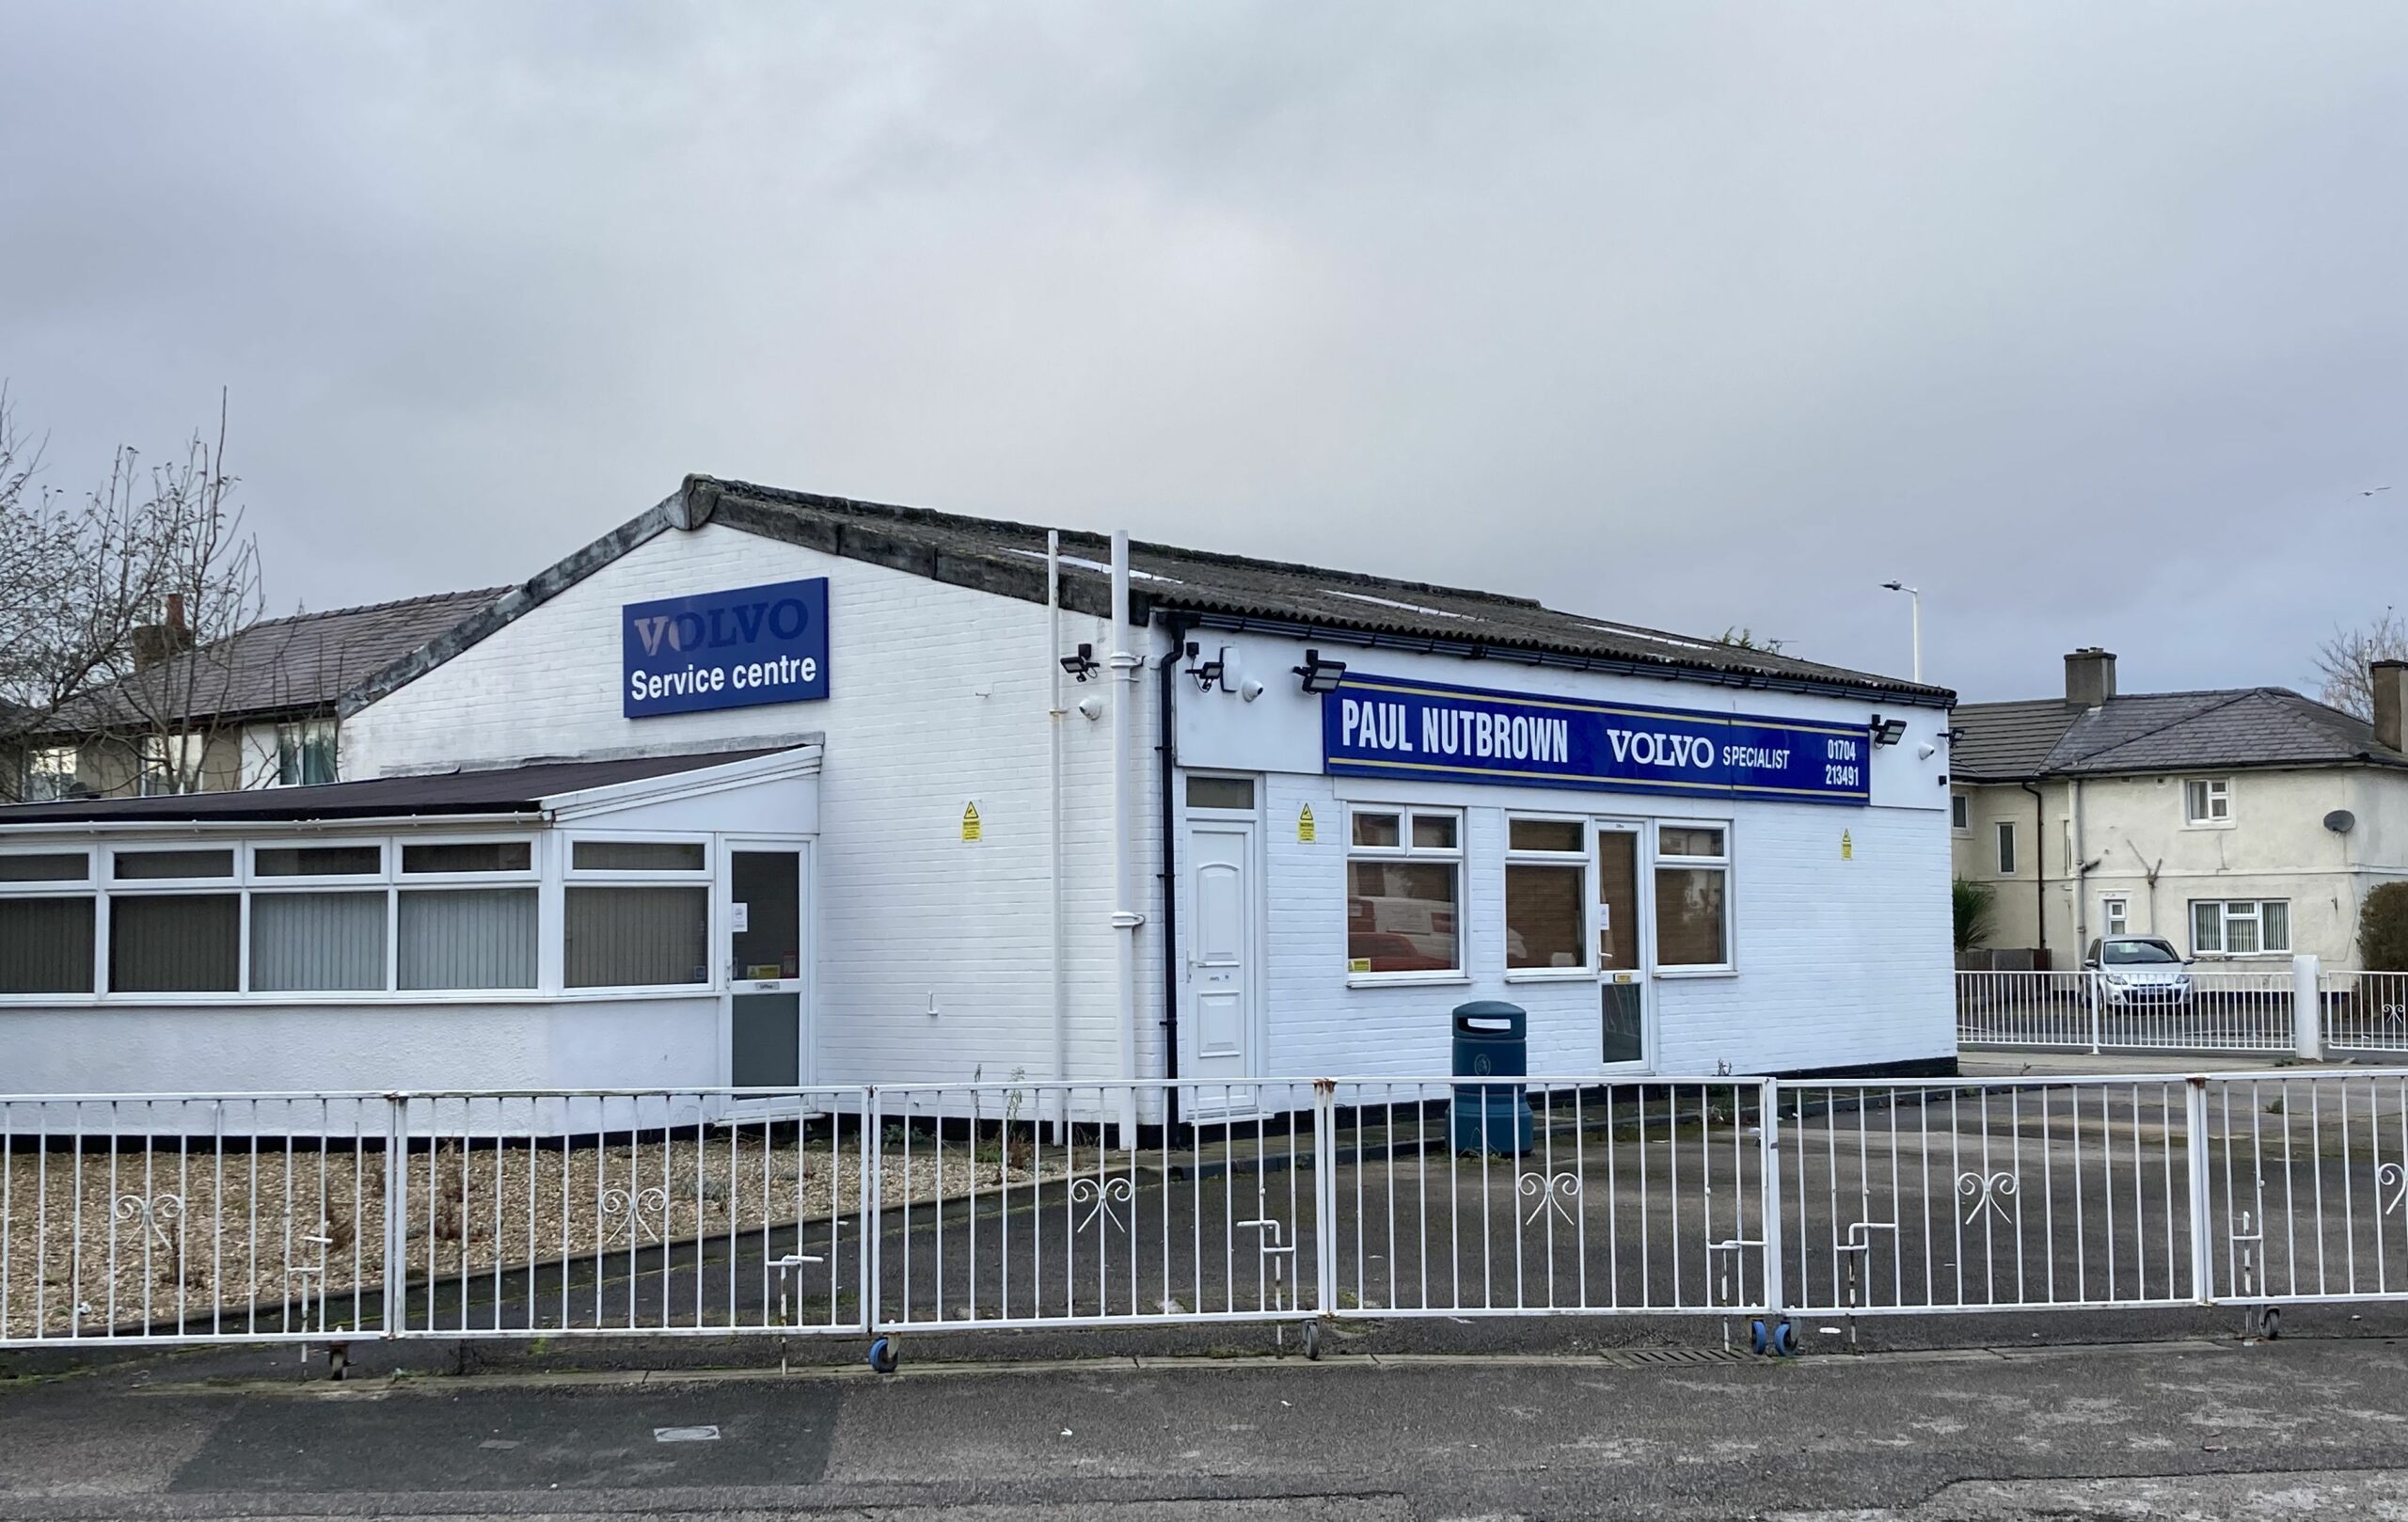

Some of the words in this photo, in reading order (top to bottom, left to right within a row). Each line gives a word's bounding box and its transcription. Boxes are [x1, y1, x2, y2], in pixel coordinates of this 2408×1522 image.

[634, 598, 808, 657] VOLVO
[631, 664, 724, 701] Service
[733, 655, 816, 690] centre
[1342, 699, 1413, 752] PAUL
[1422, 706, 1568, 763] NUTBROWN
[1607, 729, 1715, 769] VOLVO
[1722, 746, 1790, 769] SPECIALIST
[1828, 738, 1857, 762] 01704
[1826, 764, 1859, 786] 213491
